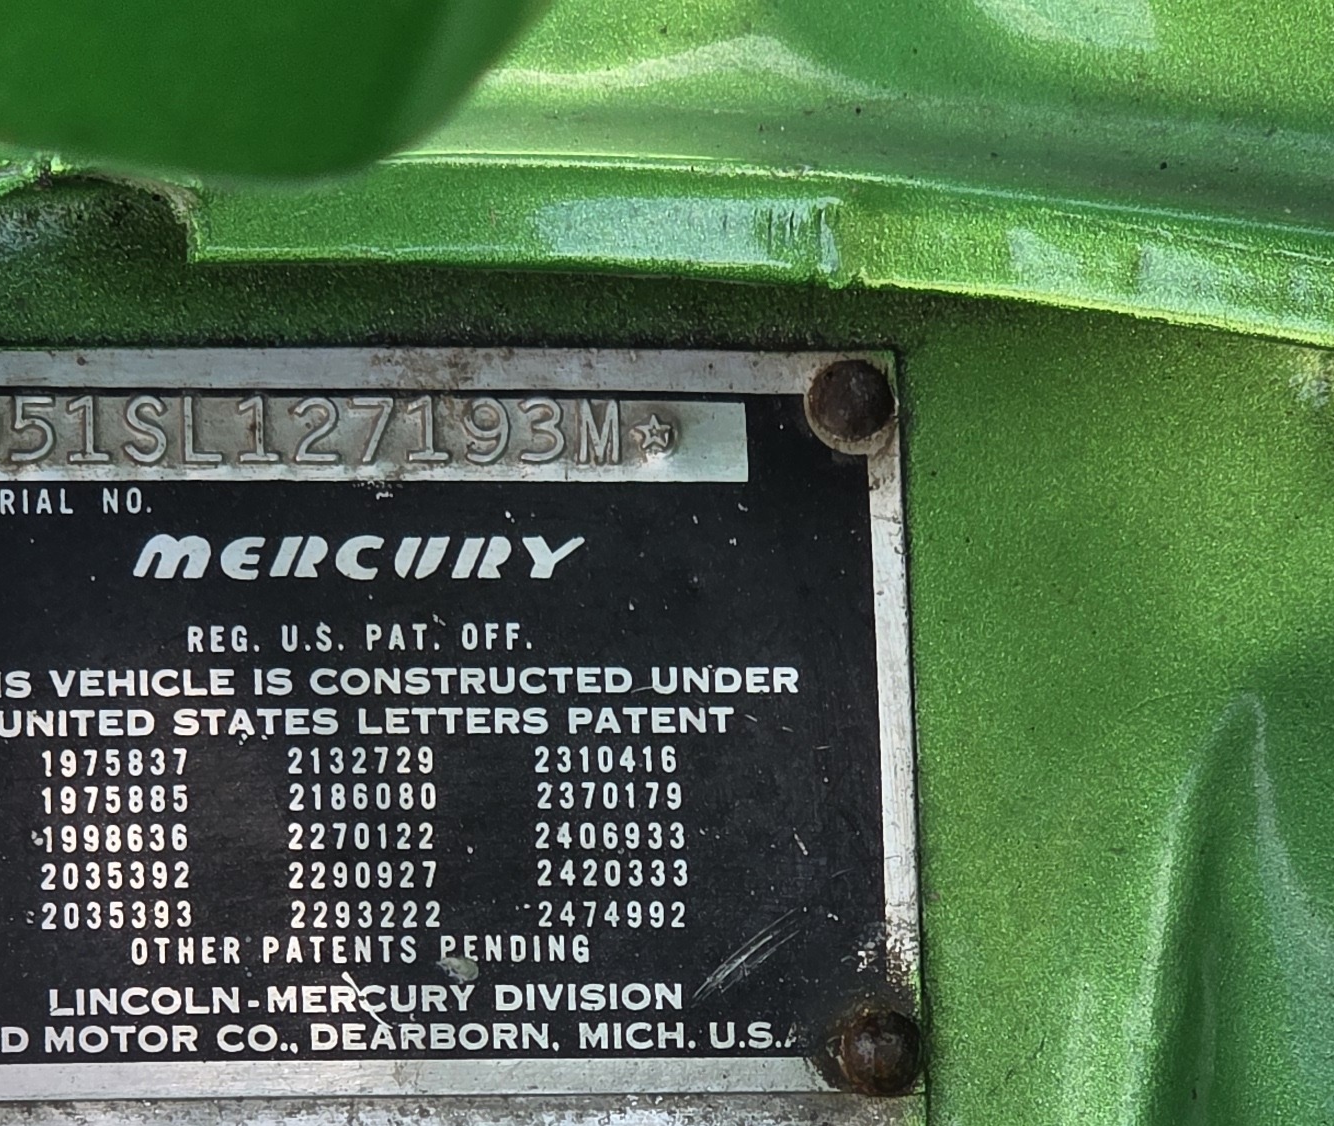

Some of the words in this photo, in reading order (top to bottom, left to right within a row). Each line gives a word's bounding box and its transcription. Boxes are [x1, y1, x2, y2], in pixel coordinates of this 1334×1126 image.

[7, 393, 624, 467] 51SL127193M
[101, 486, 154, 516] NO.
[132, 533, 586, 581] MERCURY
[187, 624, 260, 653] REG.
[281, 622, 345, 653] U.S.
[365, 623, 440, 651] PAT.
[461, 622, 532, 651] OFF.
[48, 667, 235, 698] VEHICLE
[253, 667, 293, 696] IS
[309, 666, 633, 696] CONSTRUCTED
[651, 666, 800, 695] UNDER
[173, 707, 339, 738] STATES
[358, 706, 549, 735] LETTERS
[567, 706, 735, 735] PATENT
[41, 747, 188, 778] 1975837
[287, 745, 434, 775] 2132729
[534, 745, 677, 773] 2310416
[41, 784, 188, 815] 1975885
[288, 782, 437, 812] 2186080
[537, 781, 682, 811] 2370179
[42, 823, 188, 854] 1998636
[287, 821, 434, 851] 2270122
[535, 821, 685, 850] 2406933
[40, 860, 190, 891] 2035392
[288, 860, 437, 890] 2290927
[537, 858, 688, 887] 2420333
[41, 899, 192, 930] 2035393
[290, 899, 441, 929] 2293222
[538, 900, 686, 929] 2474992
[130, 936, 241, 966] OTHER
[262, 935, 417, 964] PATENTS
[436, 934, 590, 964] PENDING
[48, 983, 476, 1017] LINCOLN-MERCURY
[494, 982, 683, 1012] DIVISION
[44, 1024, 199, 1054] MOTOR
[311, 1021, 560, 1053] DEARBORN,
[578, 1021, 696, 1050] MICH.
